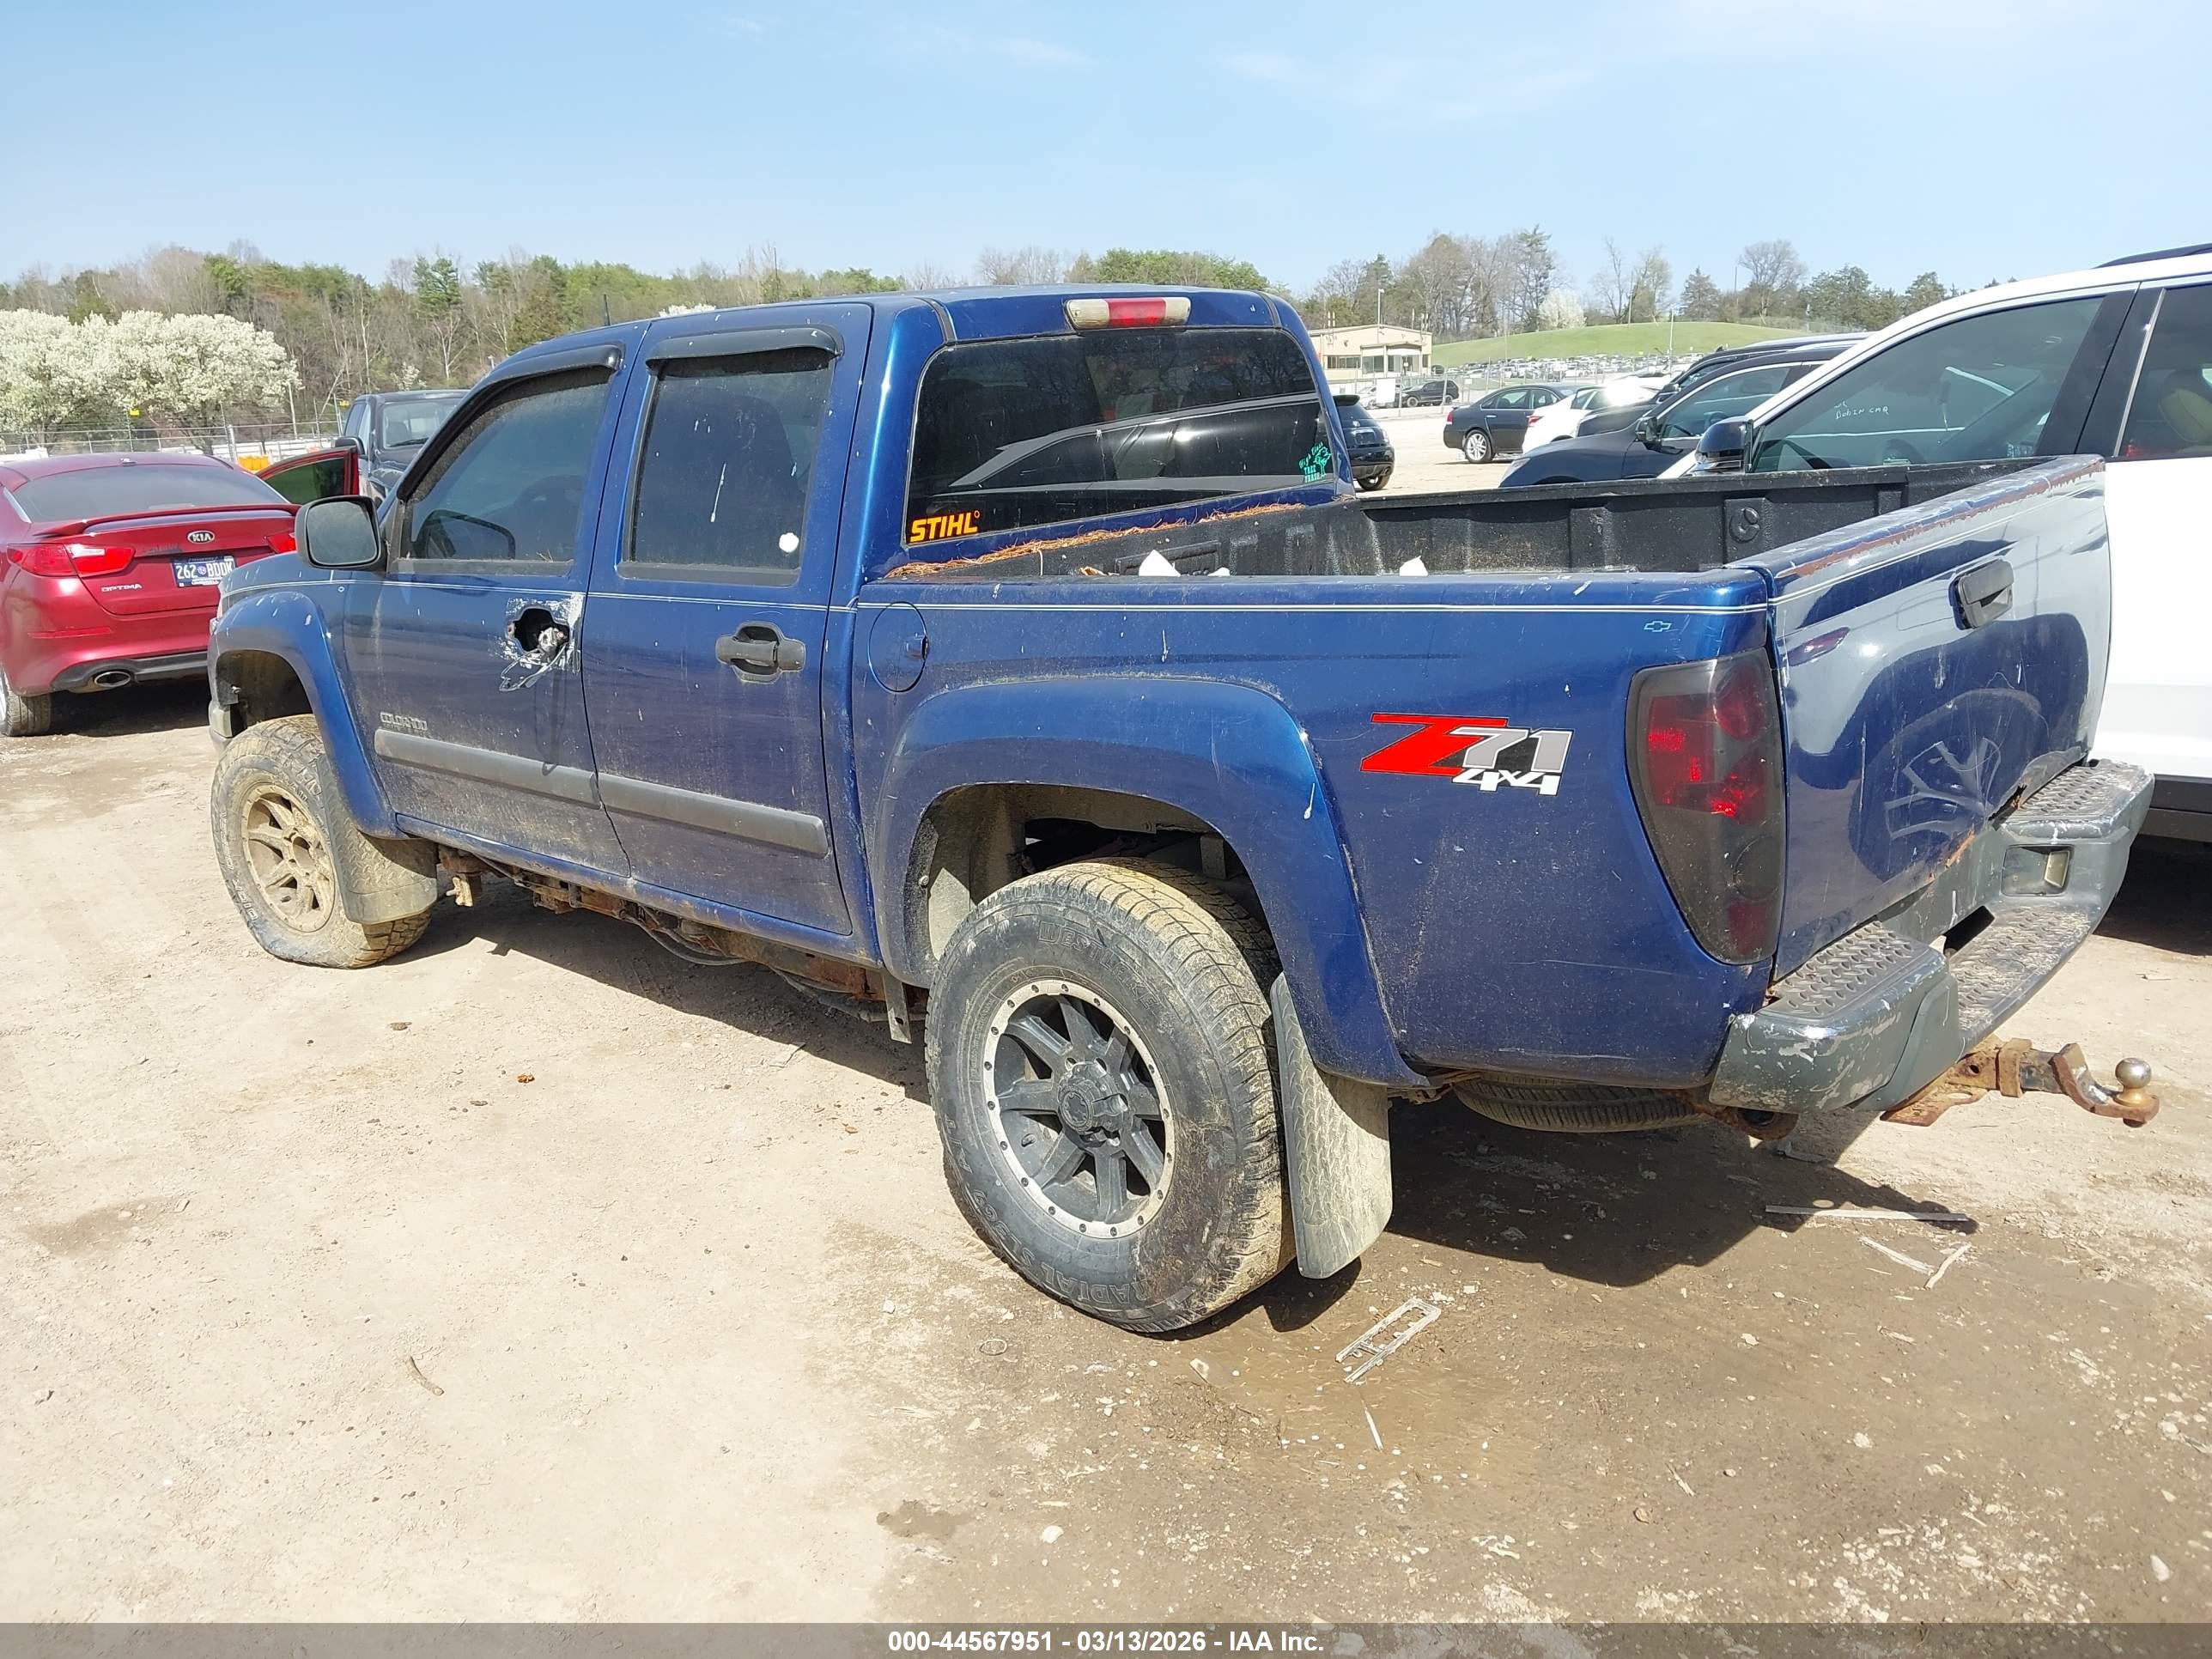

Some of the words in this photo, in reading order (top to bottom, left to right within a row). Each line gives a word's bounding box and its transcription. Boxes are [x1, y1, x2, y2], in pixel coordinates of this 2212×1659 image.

[191, 532, 213, 543] KIA
[176, 564, 198, 580] 262
[1359, 711, 1575, 778] Z71
[972, 1188, 1036, 1267] SL369
[1041, 1261, 1149, 1307] RADIAL
